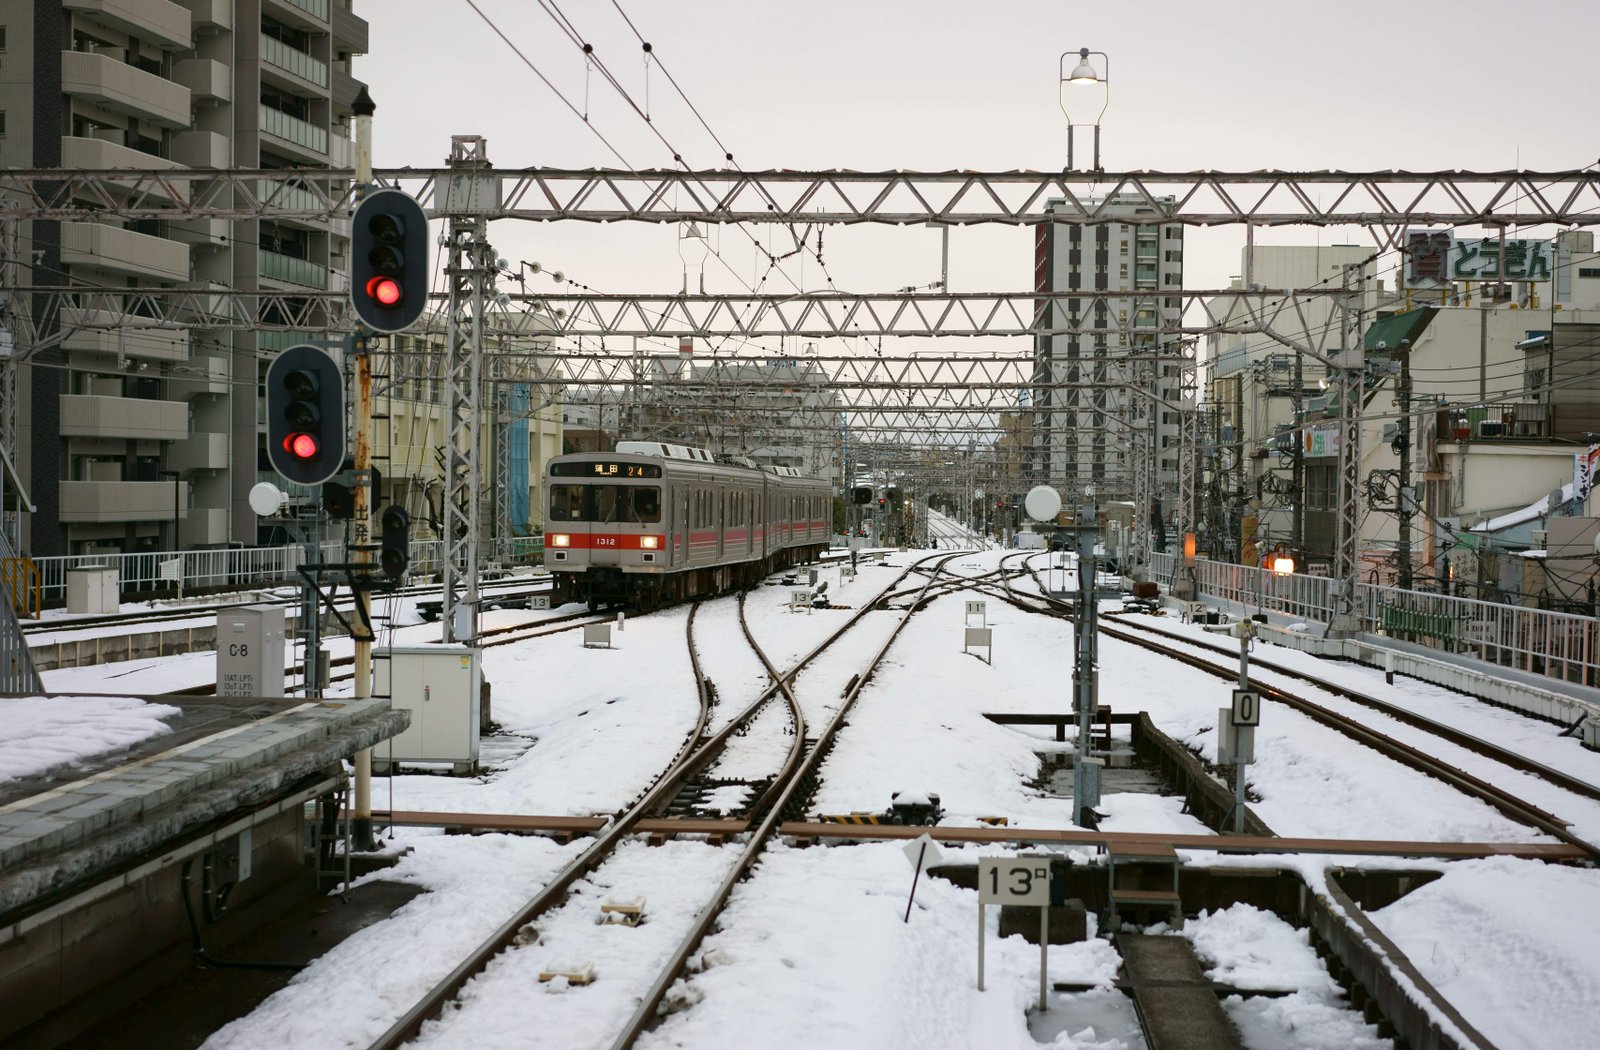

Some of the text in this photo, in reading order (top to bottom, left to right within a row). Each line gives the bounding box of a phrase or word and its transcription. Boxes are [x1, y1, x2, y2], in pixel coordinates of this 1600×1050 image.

[356, 504, 368, 543] 出発
[596, 538, 616, 546] 1312
[229, 643, 249, 657] C-8
[1241, 694, 1253, 721] 0
